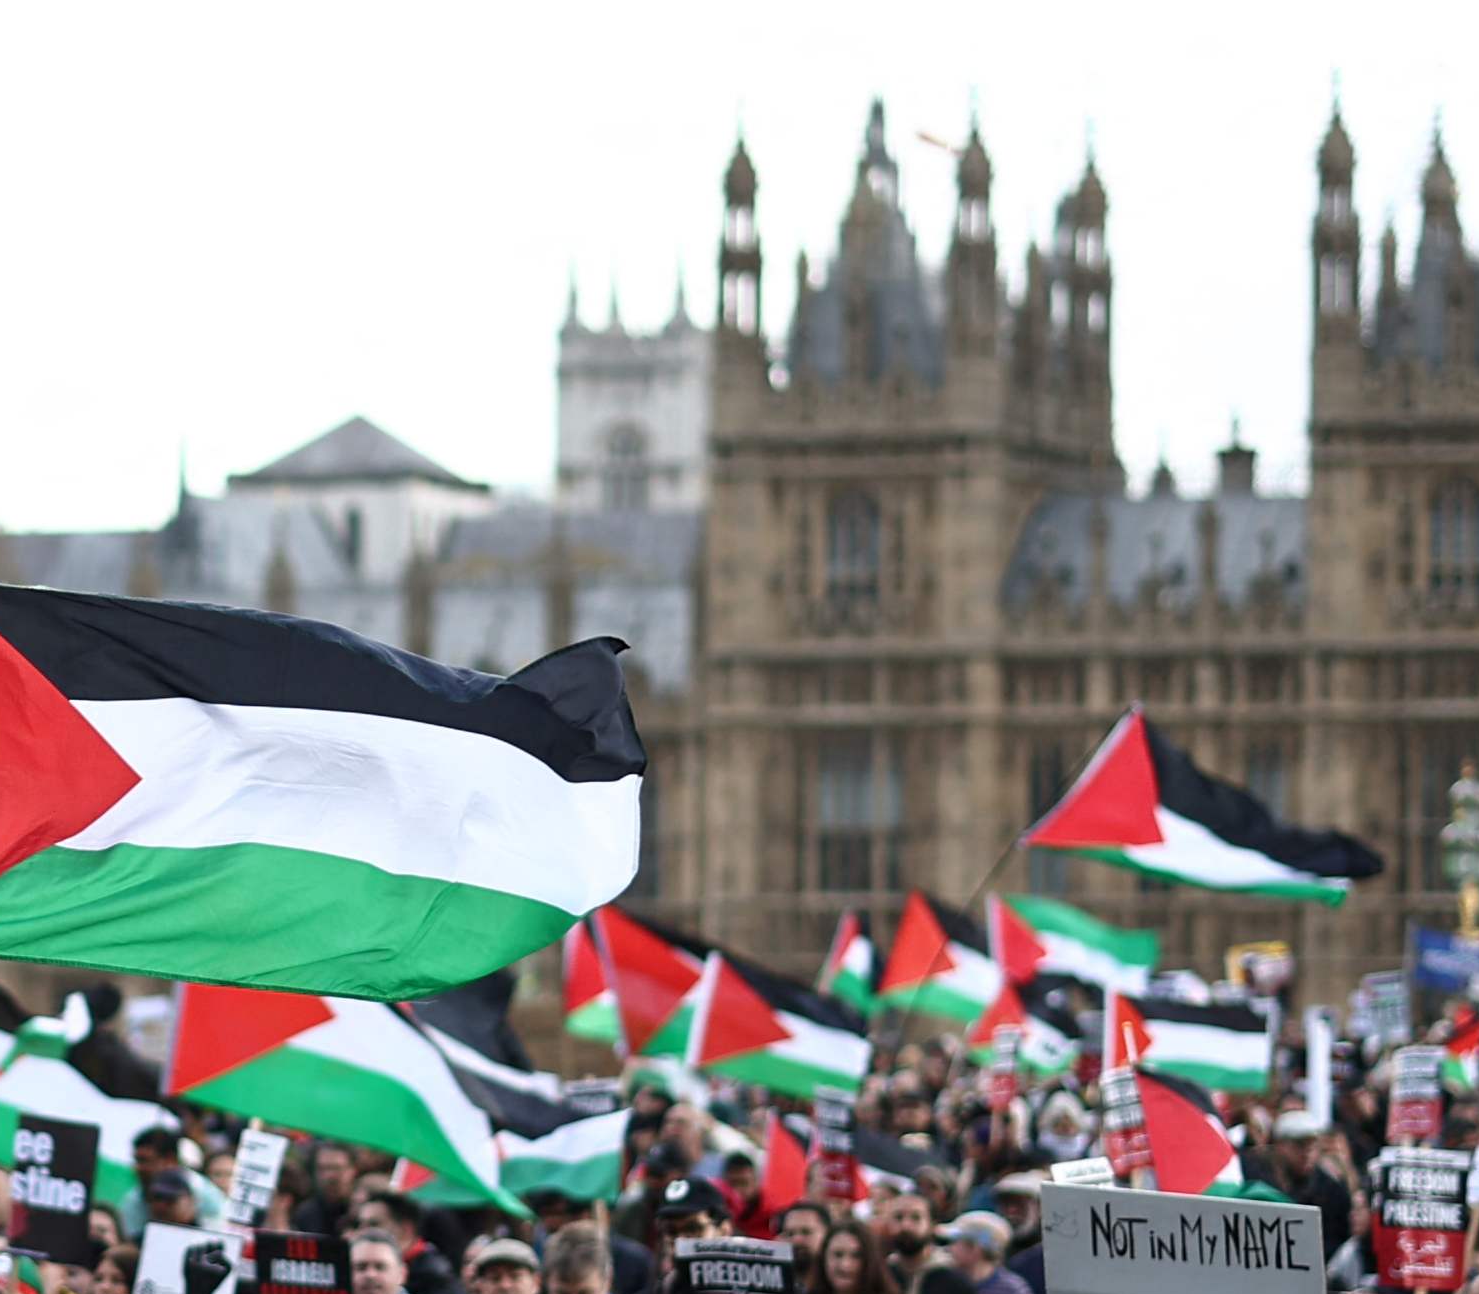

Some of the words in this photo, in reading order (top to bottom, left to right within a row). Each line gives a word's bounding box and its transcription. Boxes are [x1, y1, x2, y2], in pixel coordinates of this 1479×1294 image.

[13, 1129, 53, 1164] ee
[10, 1165, 86, 1214] stine
[1090, 1203, 1148, 1259] NOT
[1222, 1212, 1310, 1271] NAME
[690, 1260, 784, 1290] FREEDOM
